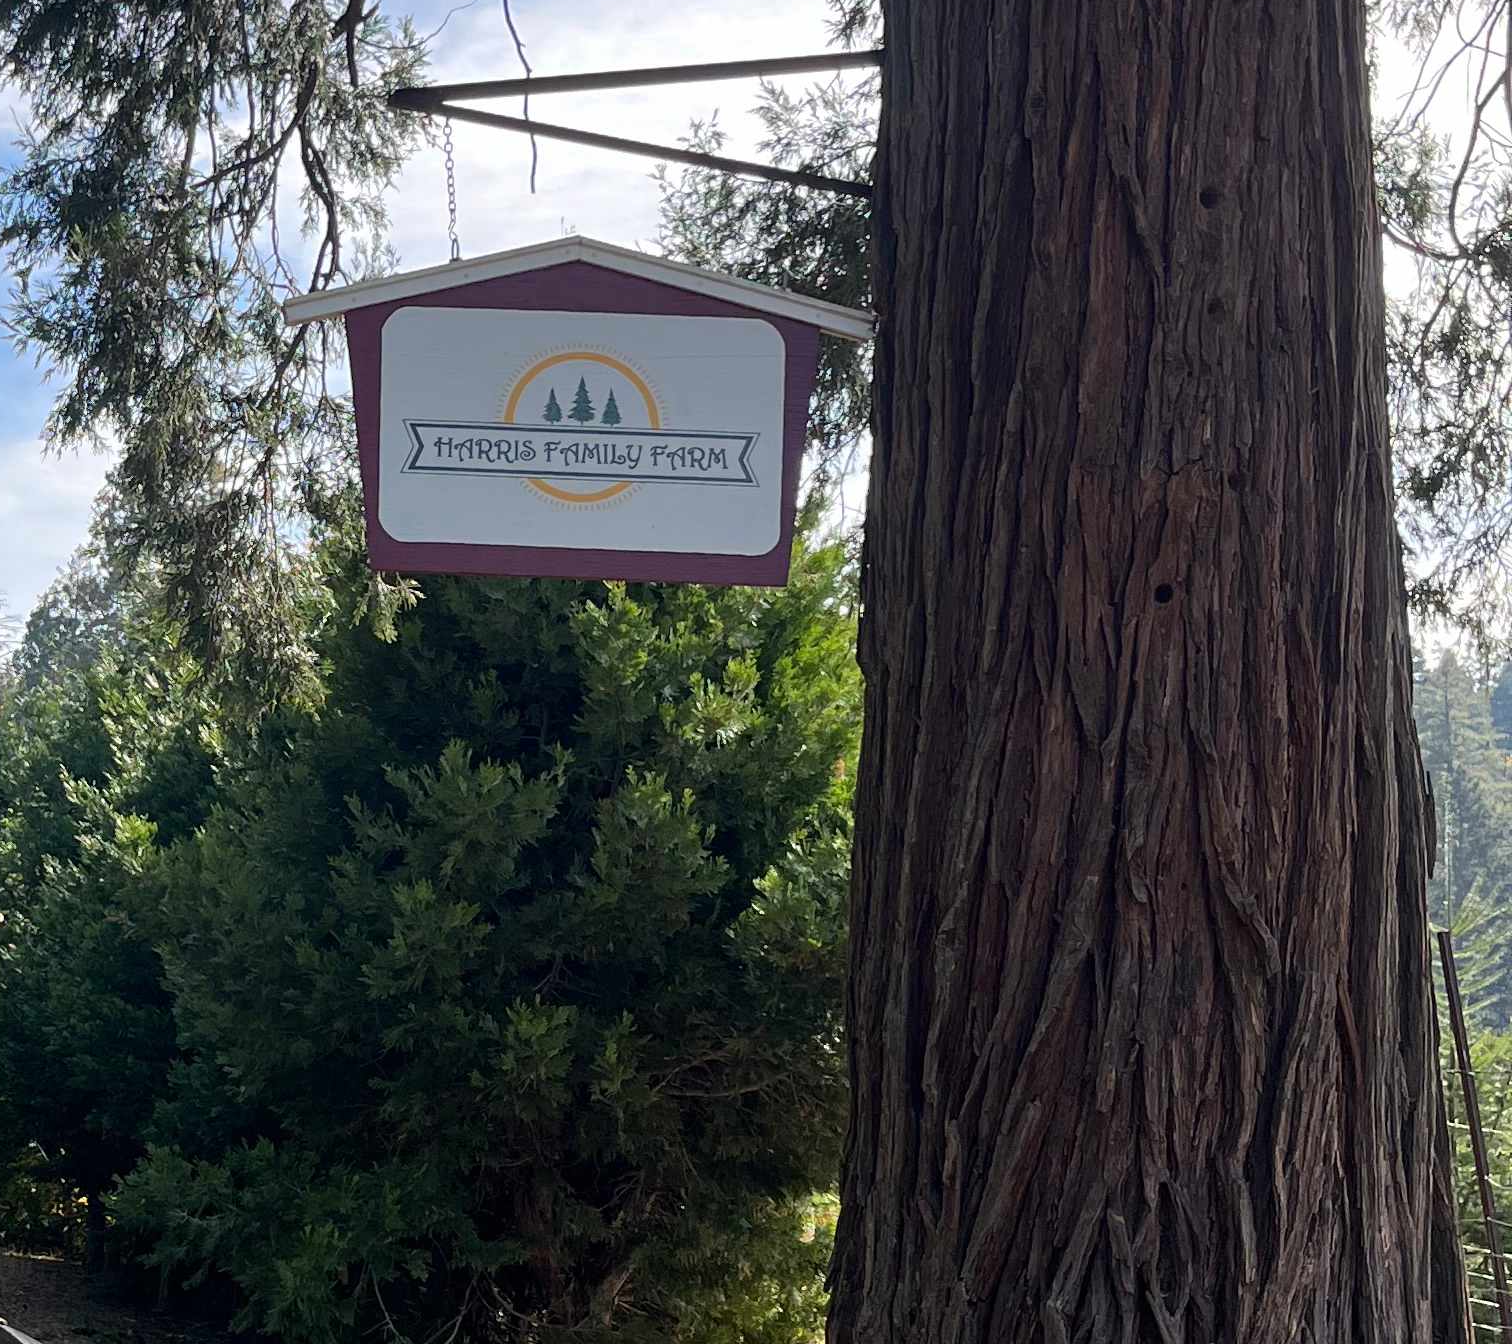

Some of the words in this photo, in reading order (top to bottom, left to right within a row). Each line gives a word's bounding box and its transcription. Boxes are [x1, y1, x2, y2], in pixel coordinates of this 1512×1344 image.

[433, 436, 537, 463] HARRIS
[543, 441, 643, 470] FAMILY
[650, 445, 729, 471] FARM
